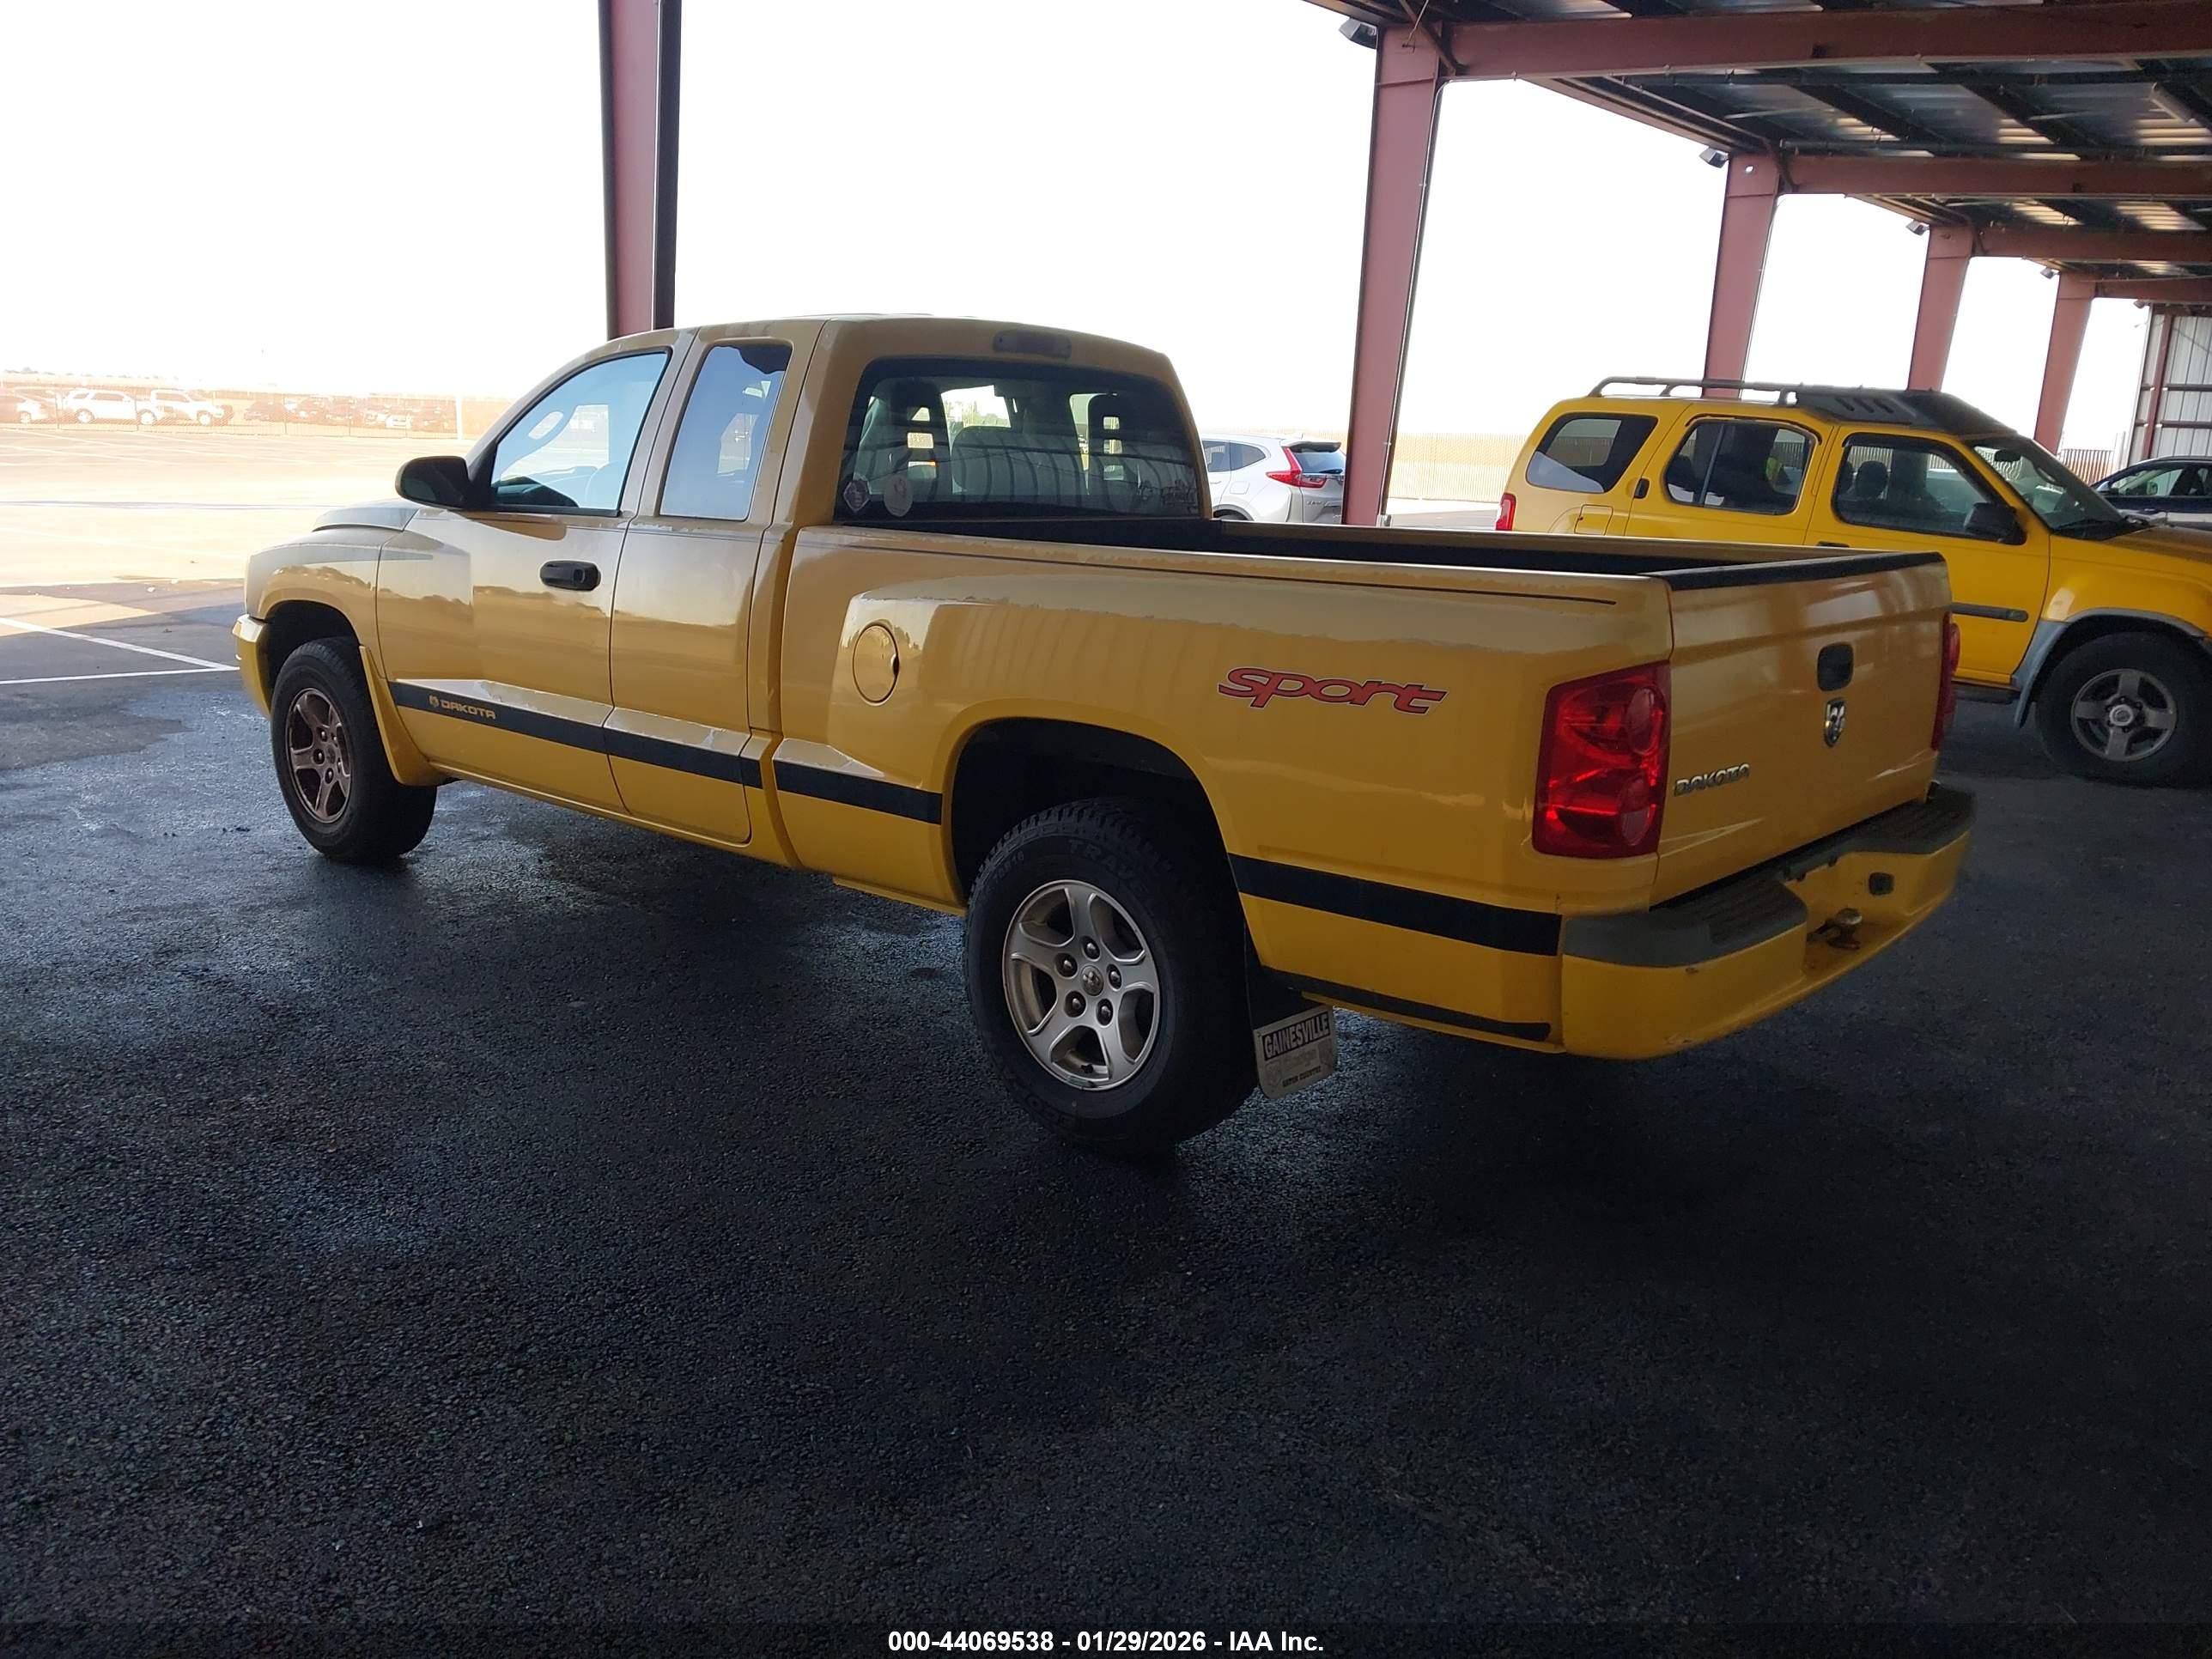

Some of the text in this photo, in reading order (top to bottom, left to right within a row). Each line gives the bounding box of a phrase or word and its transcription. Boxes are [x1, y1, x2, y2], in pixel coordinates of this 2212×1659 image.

[441, 700, 496, 719] DAKOTA
[1674, 763, 1750, 797] DAKOTA
[1264, 1013, 1330, 1060] GAINESVILLE
